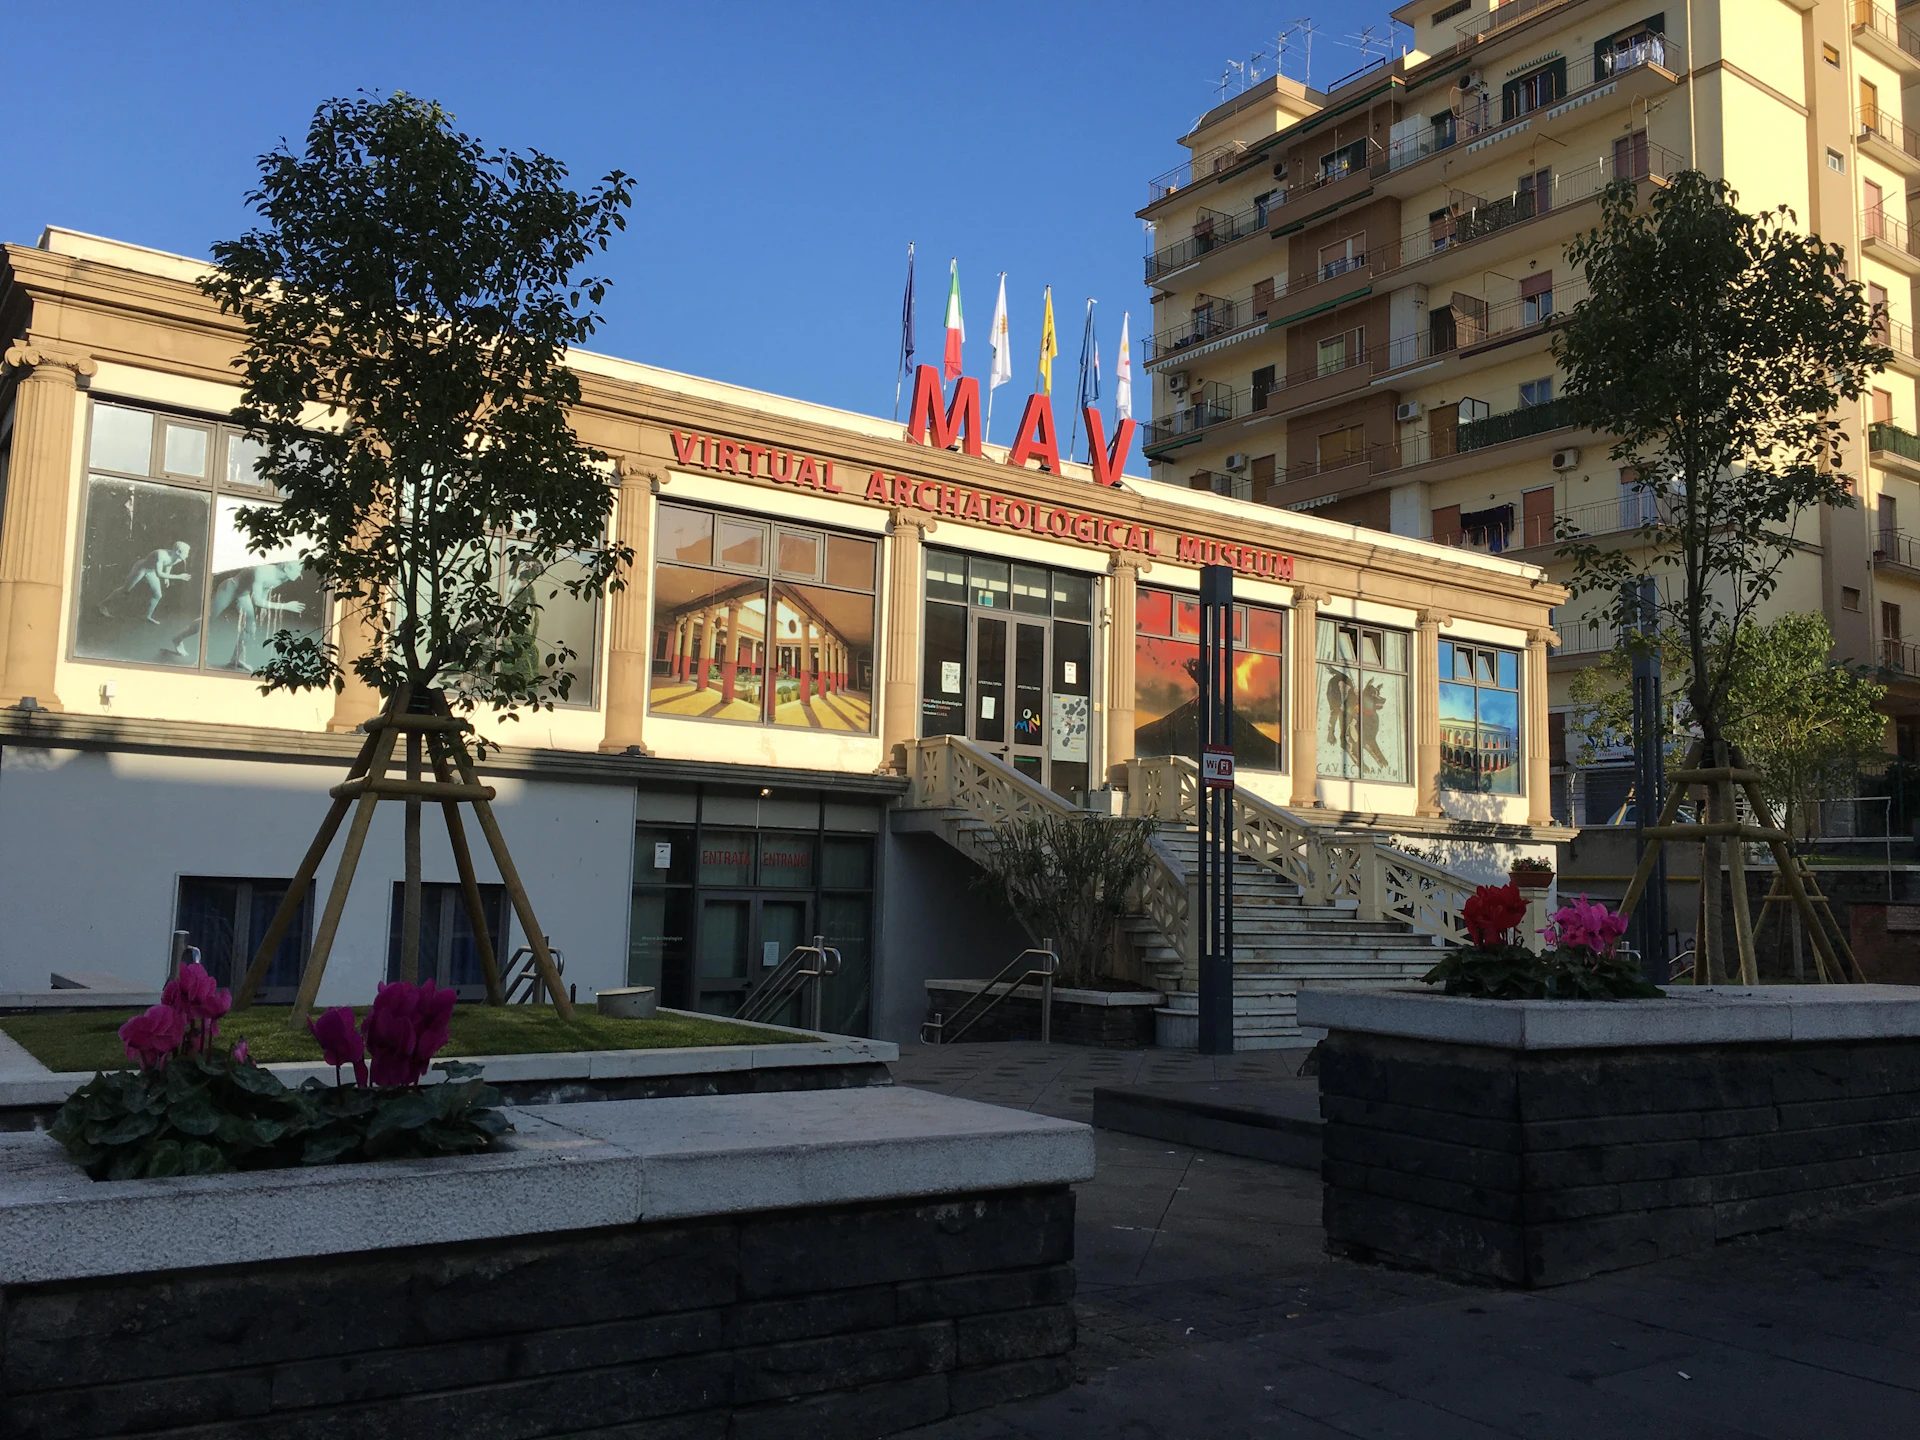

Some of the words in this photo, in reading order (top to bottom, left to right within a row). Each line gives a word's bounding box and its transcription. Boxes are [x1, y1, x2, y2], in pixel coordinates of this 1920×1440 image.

[907, 364, 1137, 487] MAV
[673, 430, 842, 493] VIRTUAL
[866, 470, 1161, 556] ARCHAEOLOGICAL
[1180, 534, 1295, 580] MUSEUM
[702, 850, 751, 867] ENTRATA
[763, 852, 812, 868] ENTRANCE
